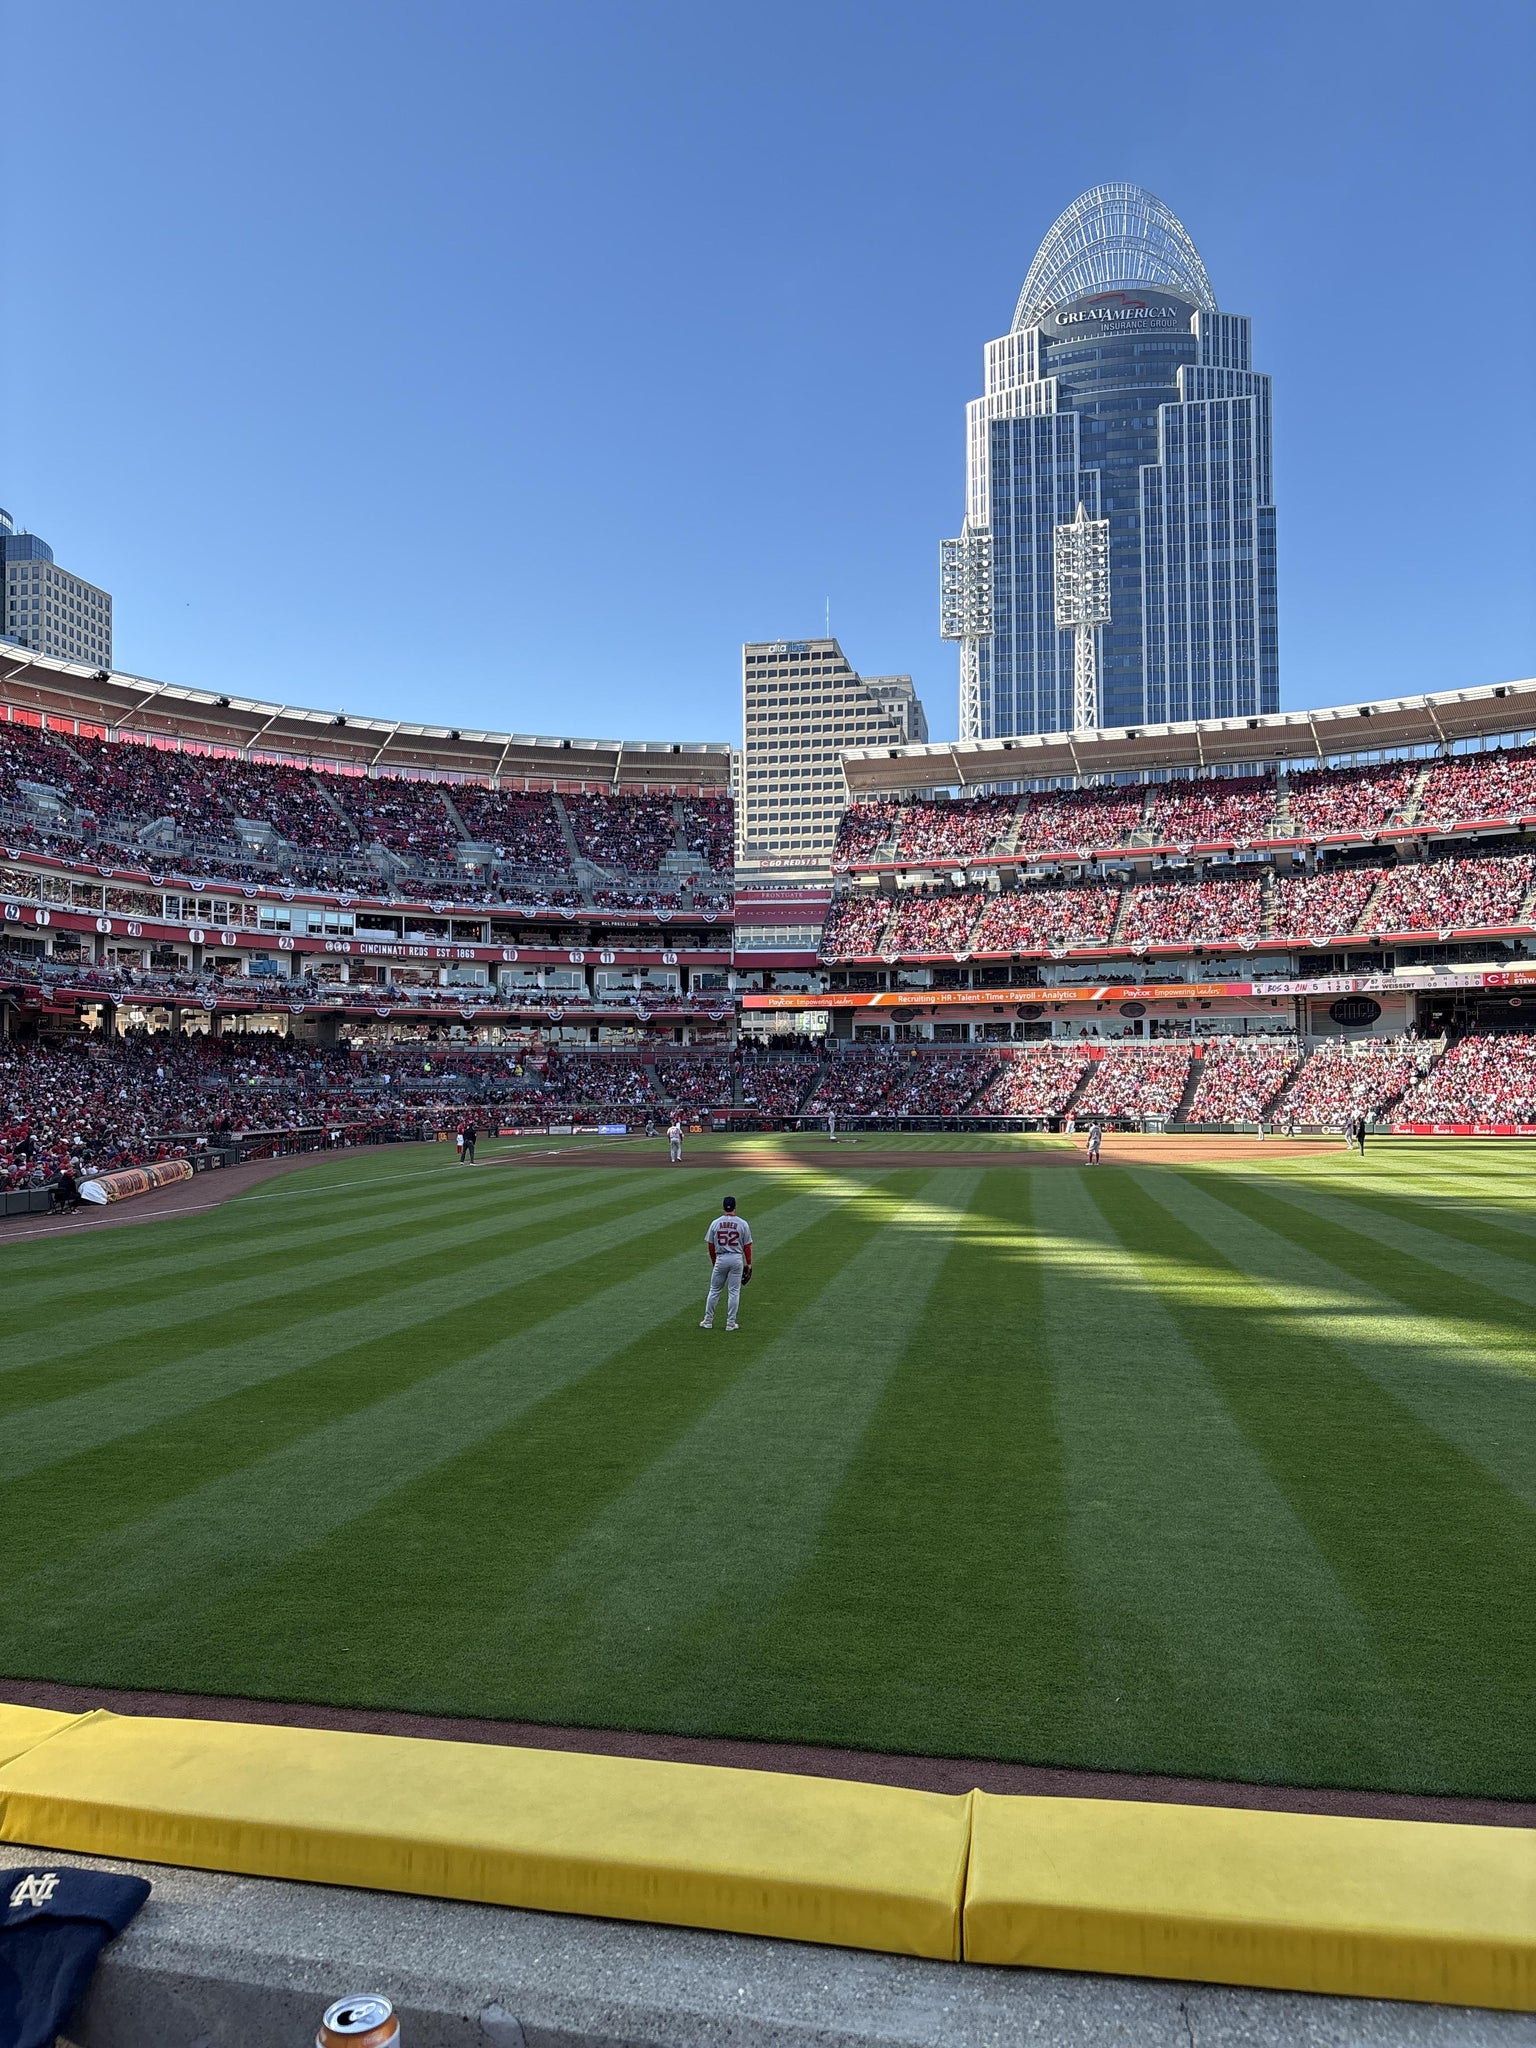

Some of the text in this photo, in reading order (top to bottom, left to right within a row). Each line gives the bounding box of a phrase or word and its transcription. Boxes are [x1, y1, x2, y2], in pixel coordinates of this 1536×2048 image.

[1101, 319, 1178, 332] INSURANCE GROUP
[6, 905, 18, 919] 42
[101, 920, 108, 931] 5
[129, 923, 141, 936] 20
[281, 938, 292, 949] 24
[360, 943, 475, 958] CINCINNATI REDS EST. 1869
[505, 950, 515, 961] 10
[572, 952, 582, 962] 13
[605, 952, 614, 963] 11
[665, 953, 675, 964] 14
[1123, 986, 1150, 997] Paycor
[1154, 988, 1195, 997] Empowering
[1295, 983, 1307, 992] CIN
[1313, 983, 1318, 991] 5
[768, 997, 793, 1006] Paycor
[797, 998, 833, 1006] Empowering
[898, 994, 936, 1003] Recruiting
[985, 992, 1004, 1001] Time
[1010, 991, 1036, 1001] Payroll
[1042, 990, 1077, 1000] Analytics
[717, 1230, 740, 1247] 52
